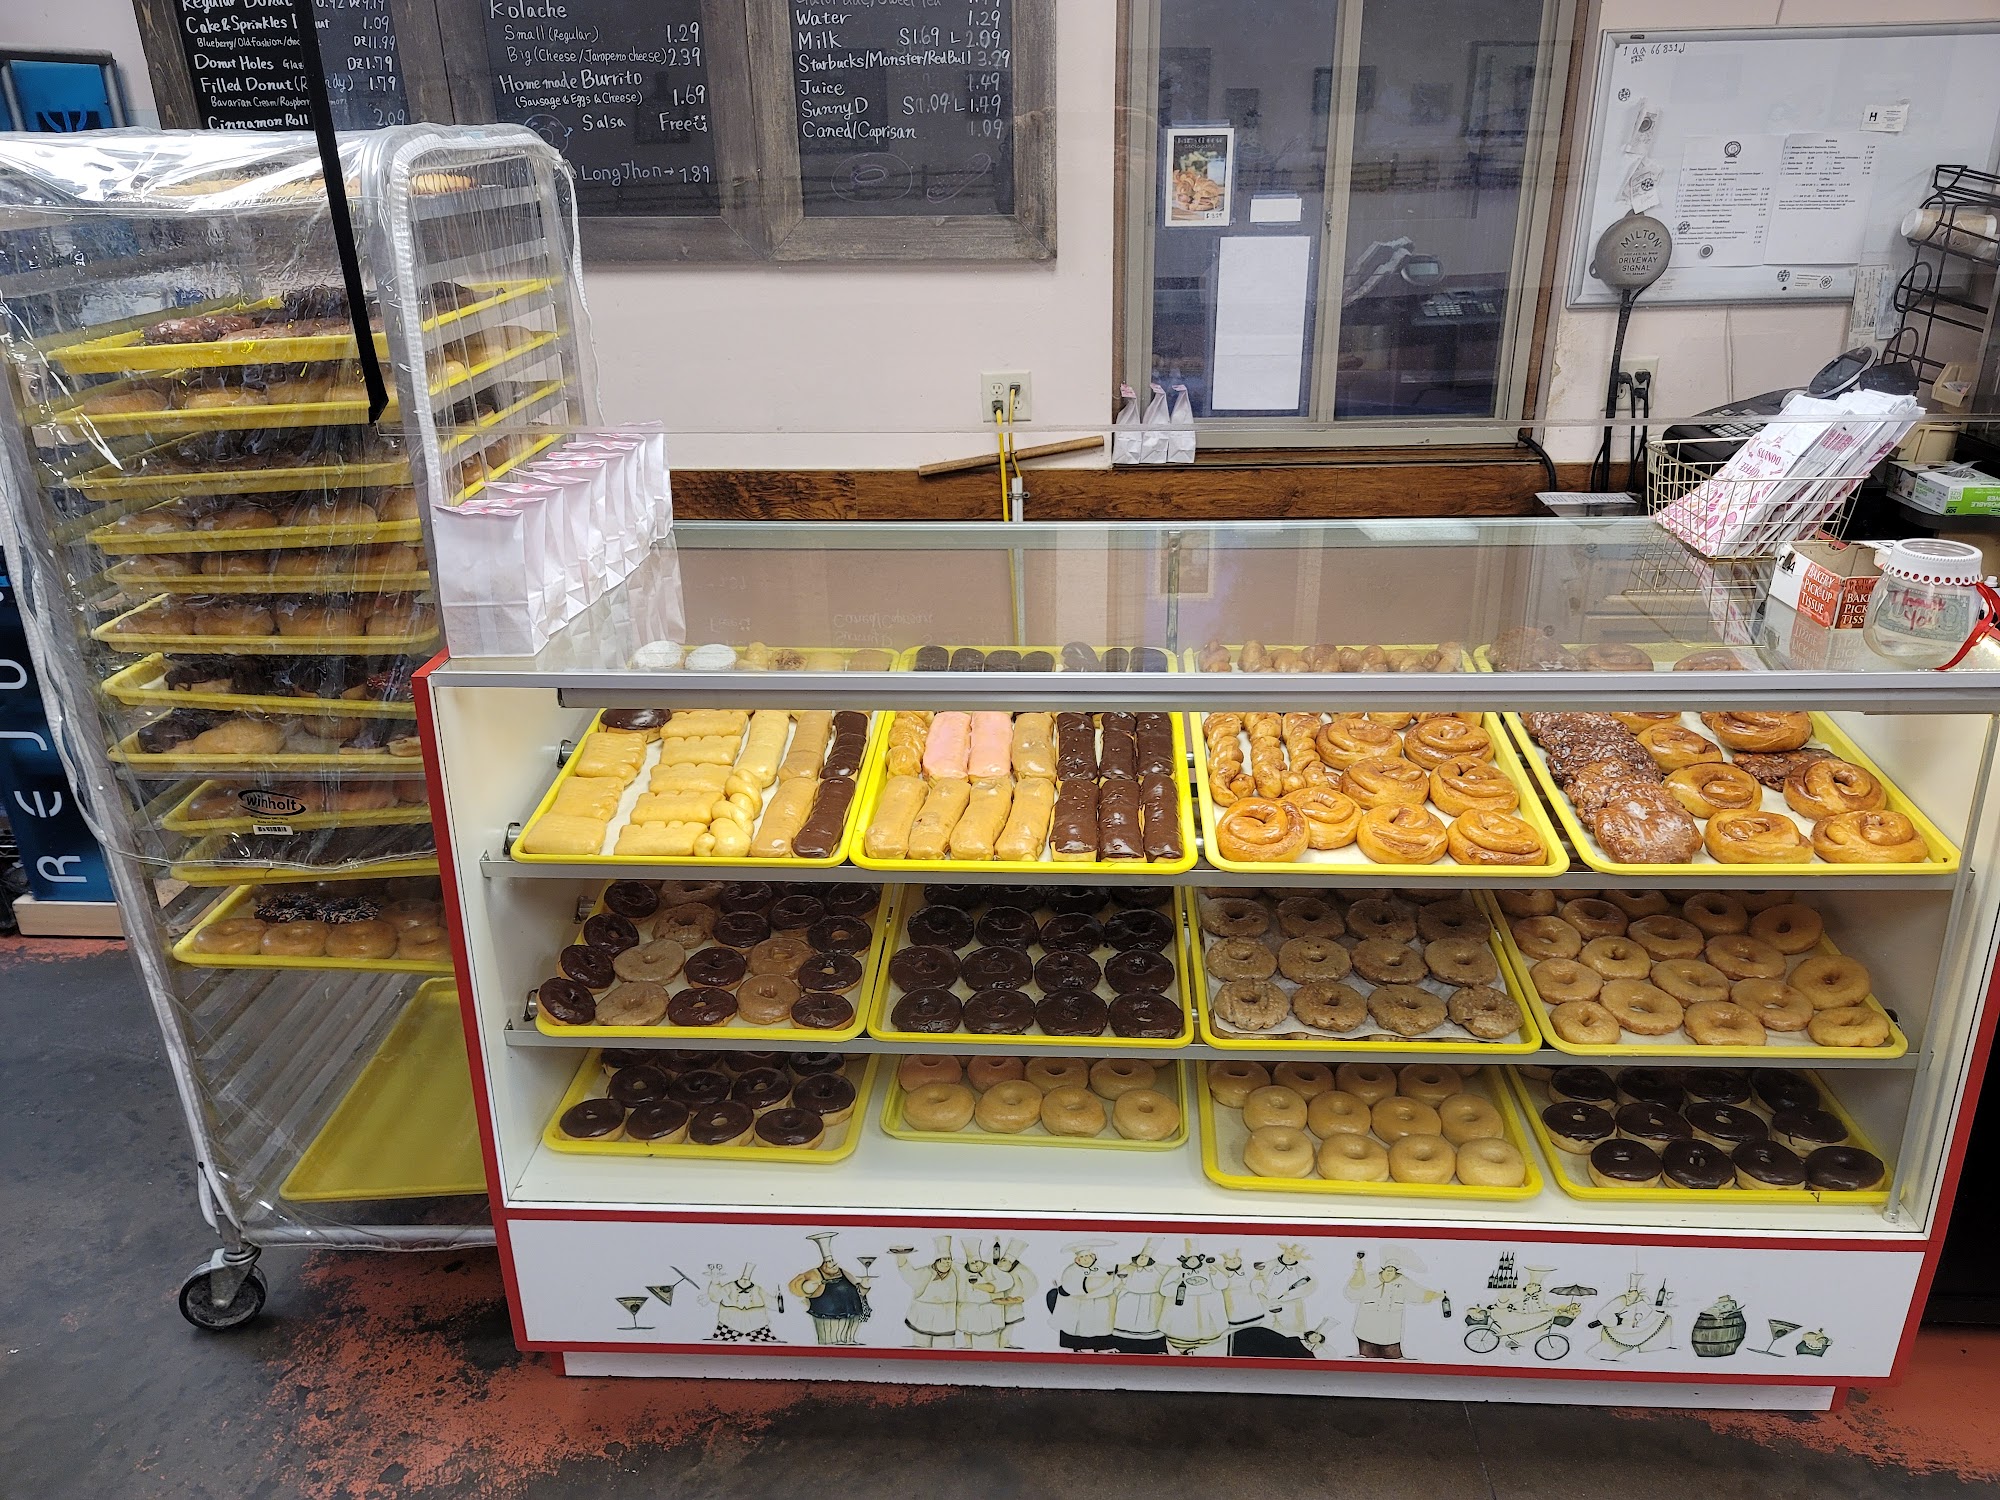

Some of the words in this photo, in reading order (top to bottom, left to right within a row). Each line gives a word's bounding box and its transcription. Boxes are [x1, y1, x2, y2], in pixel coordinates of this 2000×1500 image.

[490, 0, 568, 19] Kolache
[796, 9, 852, 26] Water
[967, 10, 1001, 29] 1.29
[363, 15, 389, 33] 1.09
[504, 24, 545, 41] Small
[548, 25, 599, 44] (Regular)
[666, 21, 699, 43] 1.29
[798, 30, 842, 51] Milk
[193, 53, 236, 70] Donut
[239, 55, 274, 70] Holes
[667, 46, 701, 67] 2.39
[977, 49, 1010, 68] 3.29
[200, 77, 242, 93] Filled
[370, 76, 396, 92] 1.79
[580, 68, 643, 89] Burrito
[800, 79, 845, 96] Juice
[210, 95, 252, 107] Bavarian
[570, 93, 591, 108] Eggs
[601, 90, 643, 105] Cheese)
[673, 84, 706, 106] 1.69
[208, 116, 283, 130] Cinnamon
[284, 113, 309, 128] Roll
[373, 108, 405, 126] 2.09
[582, 114, 627, 132] Salsa
[659, 111, 692, 132] Free
[1869, 112, 1878, 122] H
[968, 119, 1003, 140] 1.09
[1620, 229, 1663, 249] MILTON
[1622, 264, 1651, 272] SIGNAL
[1807, 564, 1836, 588] BAKERY
[1803, 578, 1833, 603] PICK-UP
[1801, 592, 1825, 615] TISSUE
[246, 794, 297, 811] Winholt
